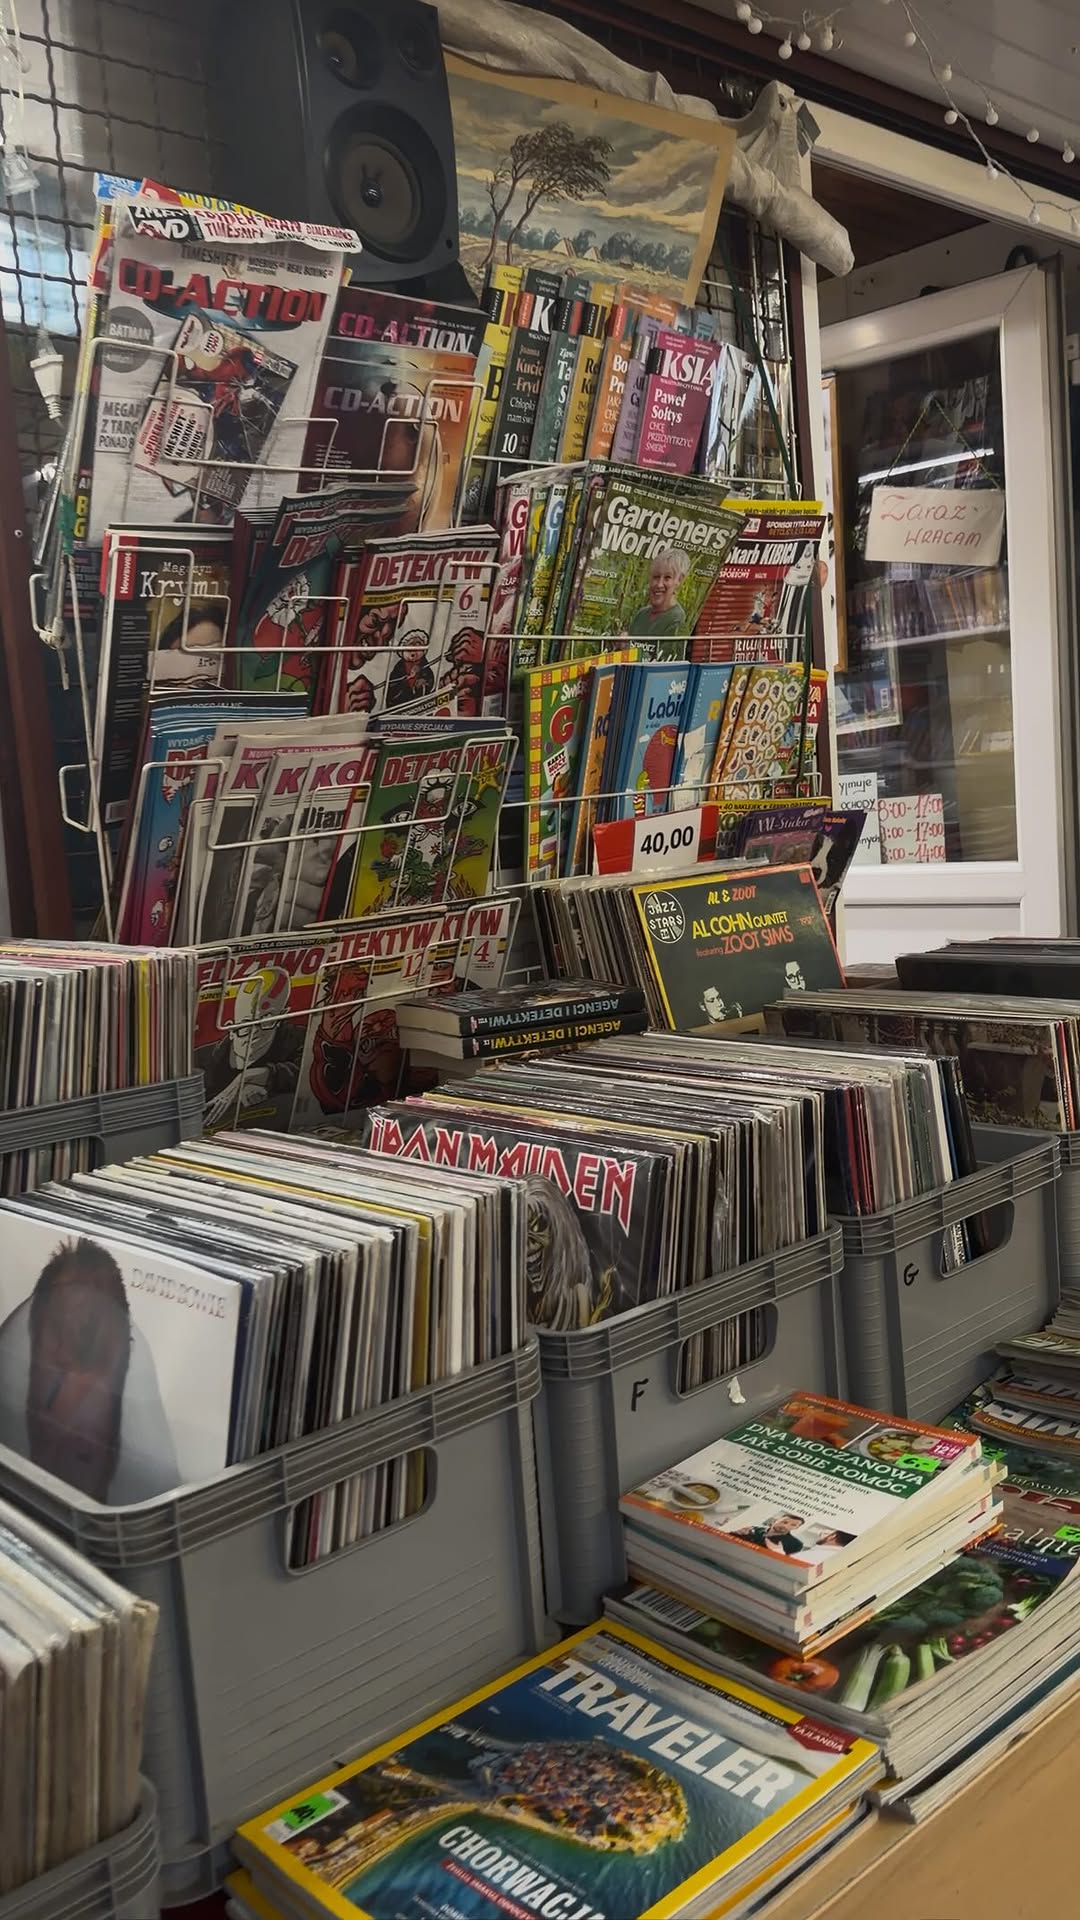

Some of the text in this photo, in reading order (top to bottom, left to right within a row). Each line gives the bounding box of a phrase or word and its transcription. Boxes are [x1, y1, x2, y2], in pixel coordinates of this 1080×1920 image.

[119, 258, 329, 323] CD-ACTION
[108, 321, 150, 340] BATMAN
[338, 311, 473, 353] CD-ACTION
[323, 386, 463, 423] CD-ACTION
[654, 388, 687, 408] Paweł
[651, 406, 684, 426] Sołtys
[501, 433, 518, 454] 10
[881, 494, 967, 522] Zaraz
[607, 496, 738, 550] Gardeners'
[601, 522, 675, 560] World
[904, 528, 983, 548] WRACAM
[760, 541, 799, 565] KIBICA
[162, 561, 213, 576] Magzyn
[369, 550, 490, 587] DETEKTYW
[459, 585, 475, 611] 6
[414, 723, 456, 731] SPECJALNE
[380, 742, 505, 787] DETEKTYW
[640, 825, 694, 856] 40,00
[648, 901, 677, 915] JAZZ
[707, 891, 721, 905] AL
[732, 885, 757, 901] ZOOT
[649, 915, 683, 930] STARS
[692, 919, 711, 939] AL
[710, 912, 753, 936] COHN
[753, 911, 789, 928] QUINTET
[474, 939, 490, 962] 4
[722, 931, 760, 954] ZOOT
[761, 925, 795, 946] SIMS
[488, 1007, 563, 1028] DETEKTYWI
[573, 998, 619, 1014] AGENCI
[491, 1029, 565, 1050] DETEKTYWI
[575, 1019, 622, 1037] AGENCI
[369, 1118, 638, 1238] IRON MAIDEN
[903, 1262, 920, 1287] G
[130, 1267, 228, 1319] DAVID BOWIE
[630, 1378, 649, 1412] F
[734, 1434, 909, 1494] JAK SOBIE POMÓC
[746, 1423, 924, 1486] DNA MOCZANOWA
[540, 1656, 796, 1809] TRAVELER
[792, 1725, 844, 1752] TAJLANDIA
[438, 1825, 607, 1920] CHORWACJ
